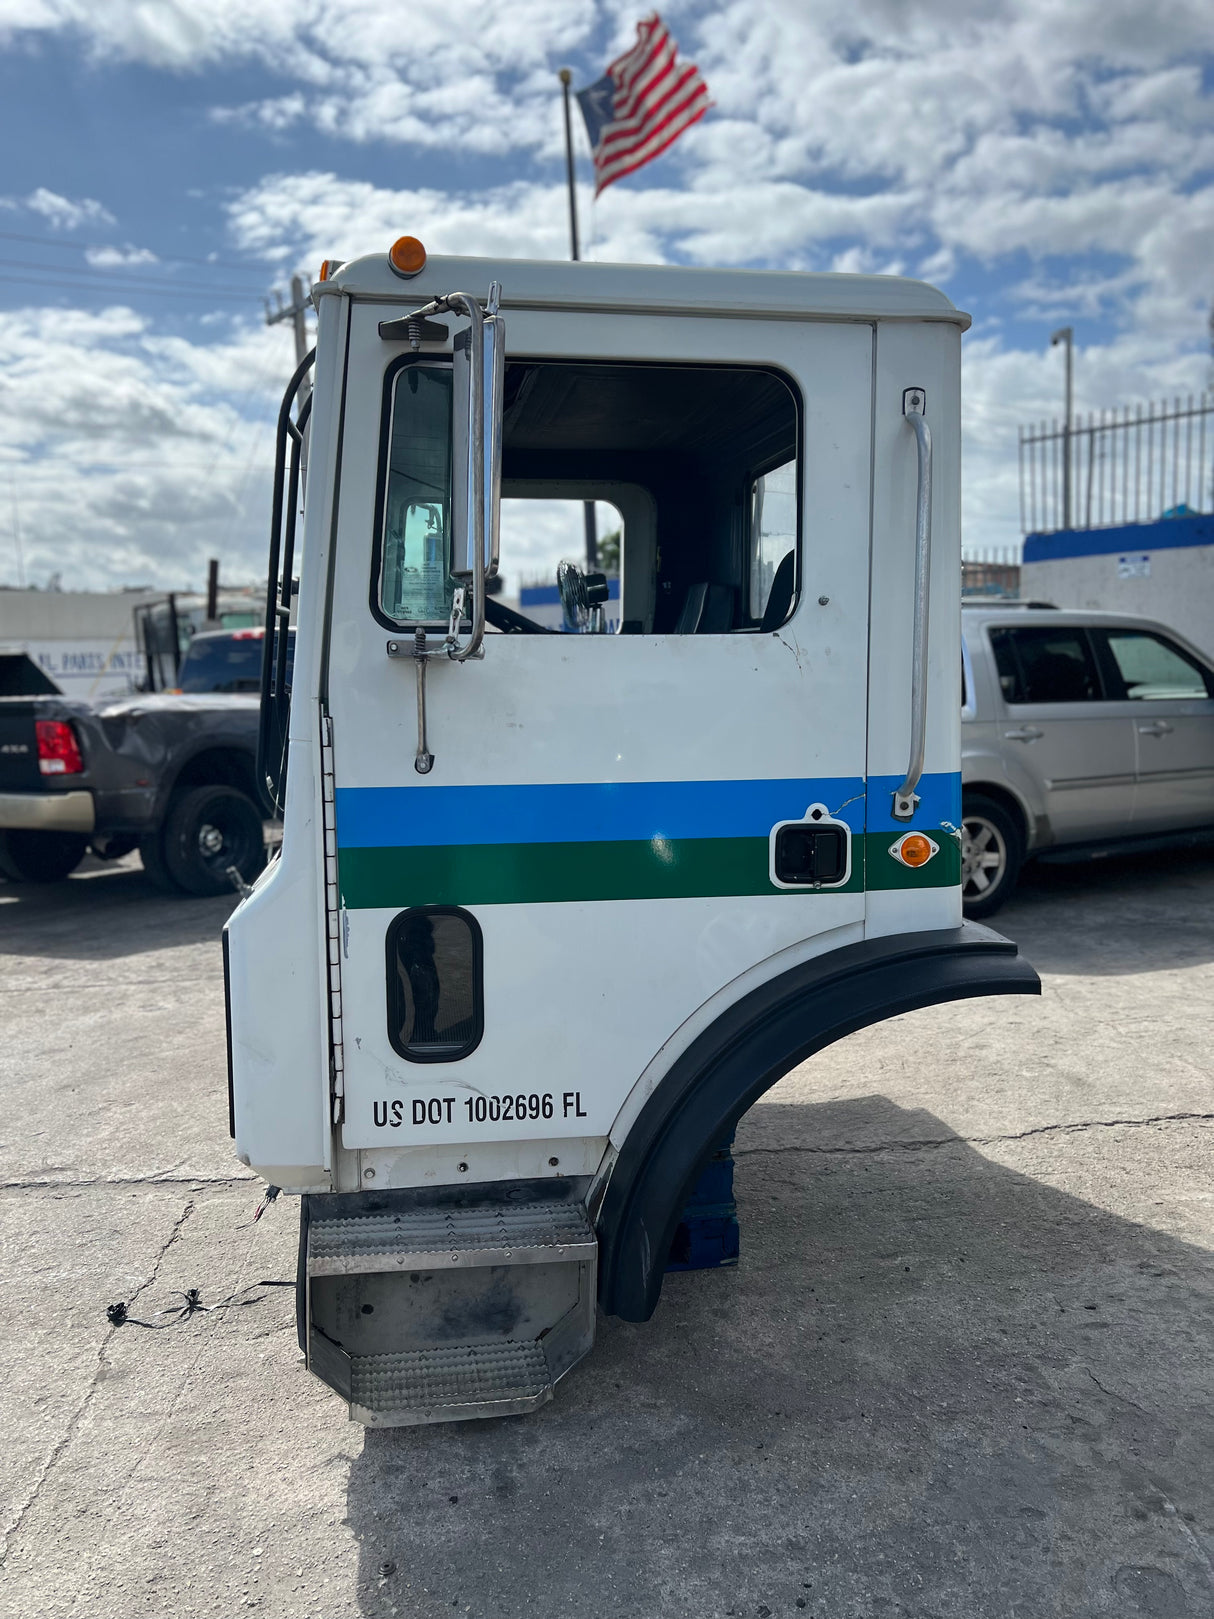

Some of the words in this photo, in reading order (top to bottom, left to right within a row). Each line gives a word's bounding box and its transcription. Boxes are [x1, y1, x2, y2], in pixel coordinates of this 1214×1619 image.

[373, 1100, 404, 1127] US
[412, 1098, 456, 1125] DOT
[464, 1093, 554, 1122] 1002696
[563, 1092, 588, 1118] FL
